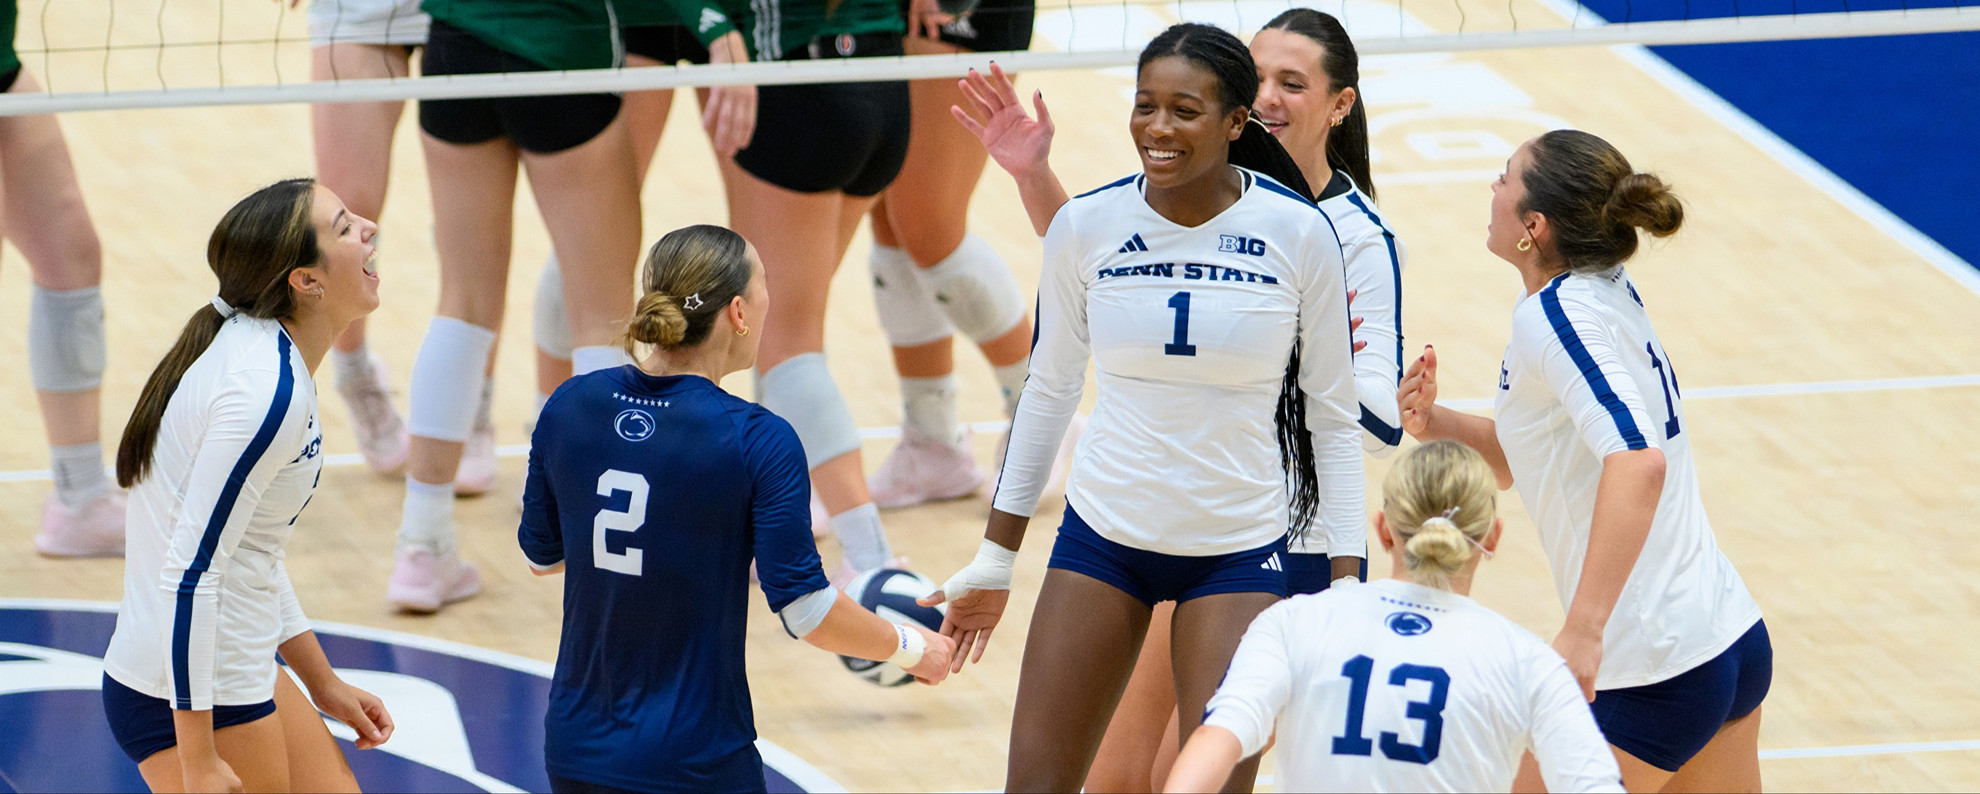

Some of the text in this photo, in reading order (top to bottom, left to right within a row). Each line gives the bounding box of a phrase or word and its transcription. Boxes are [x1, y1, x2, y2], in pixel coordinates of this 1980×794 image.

[1164, 291, 1197, 357] 1
[1646, 340, 1681, 441] 1
[592, 468, 650, 577] 2
[1331, 653, 1451, 765] 13
